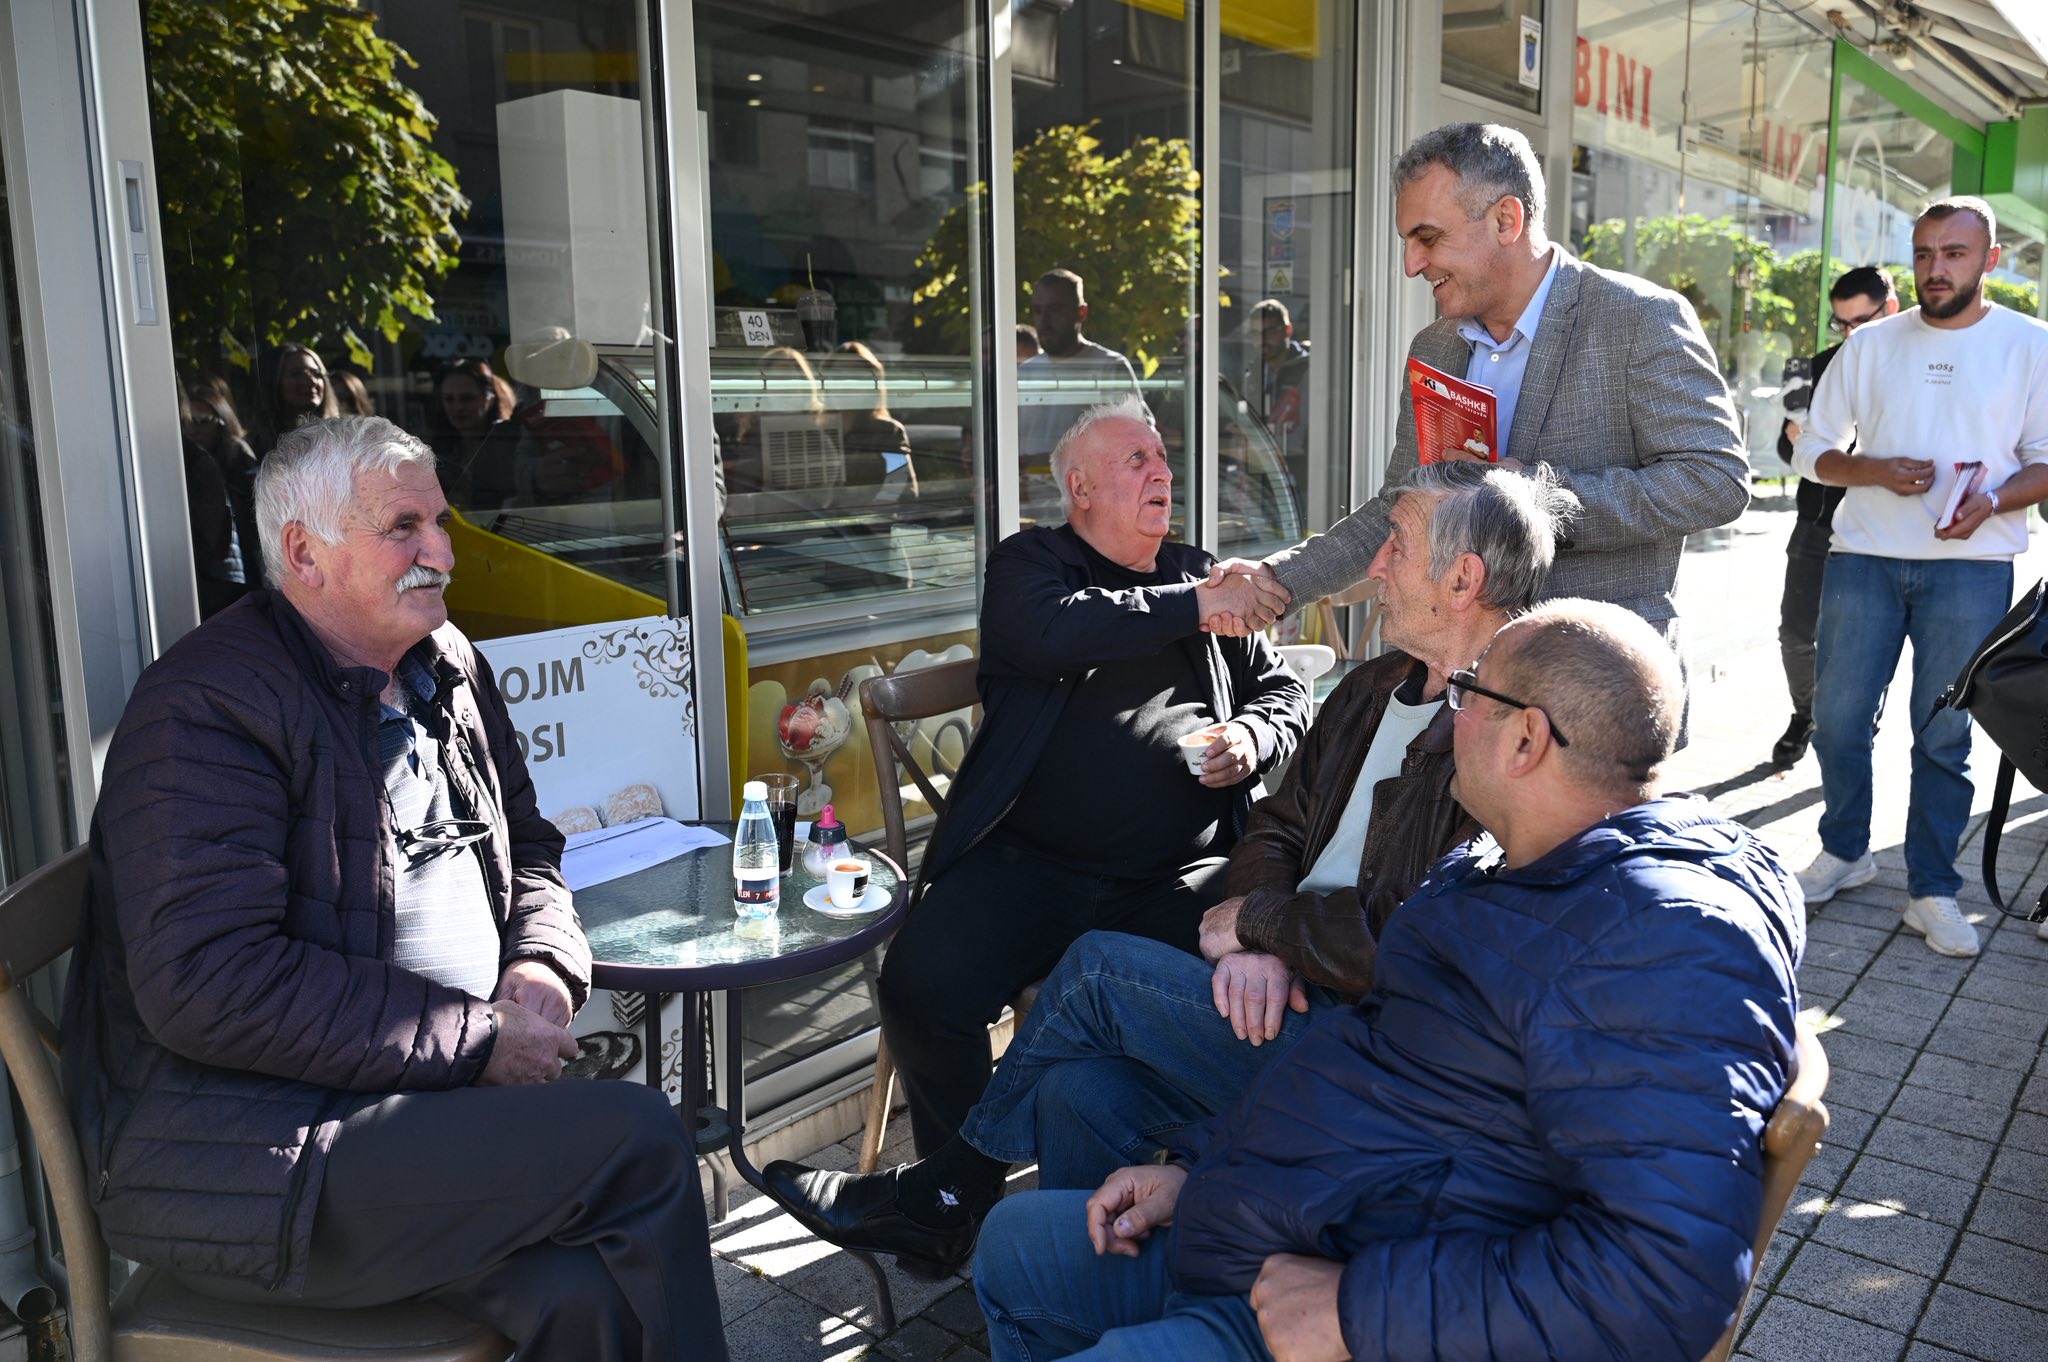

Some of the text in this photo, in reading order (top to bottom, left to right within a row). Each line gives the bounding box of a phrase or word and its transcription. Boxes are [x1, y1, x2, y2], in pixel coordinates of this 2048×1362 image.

[1575, 35, 1652, 129] BINI
[748, 315, 763, 328] 40
[749, 331, 770, 341] DEN
[1928, 363, 1954, 373] BOSS
[1450, 391, 1487, 413] BASHKË
